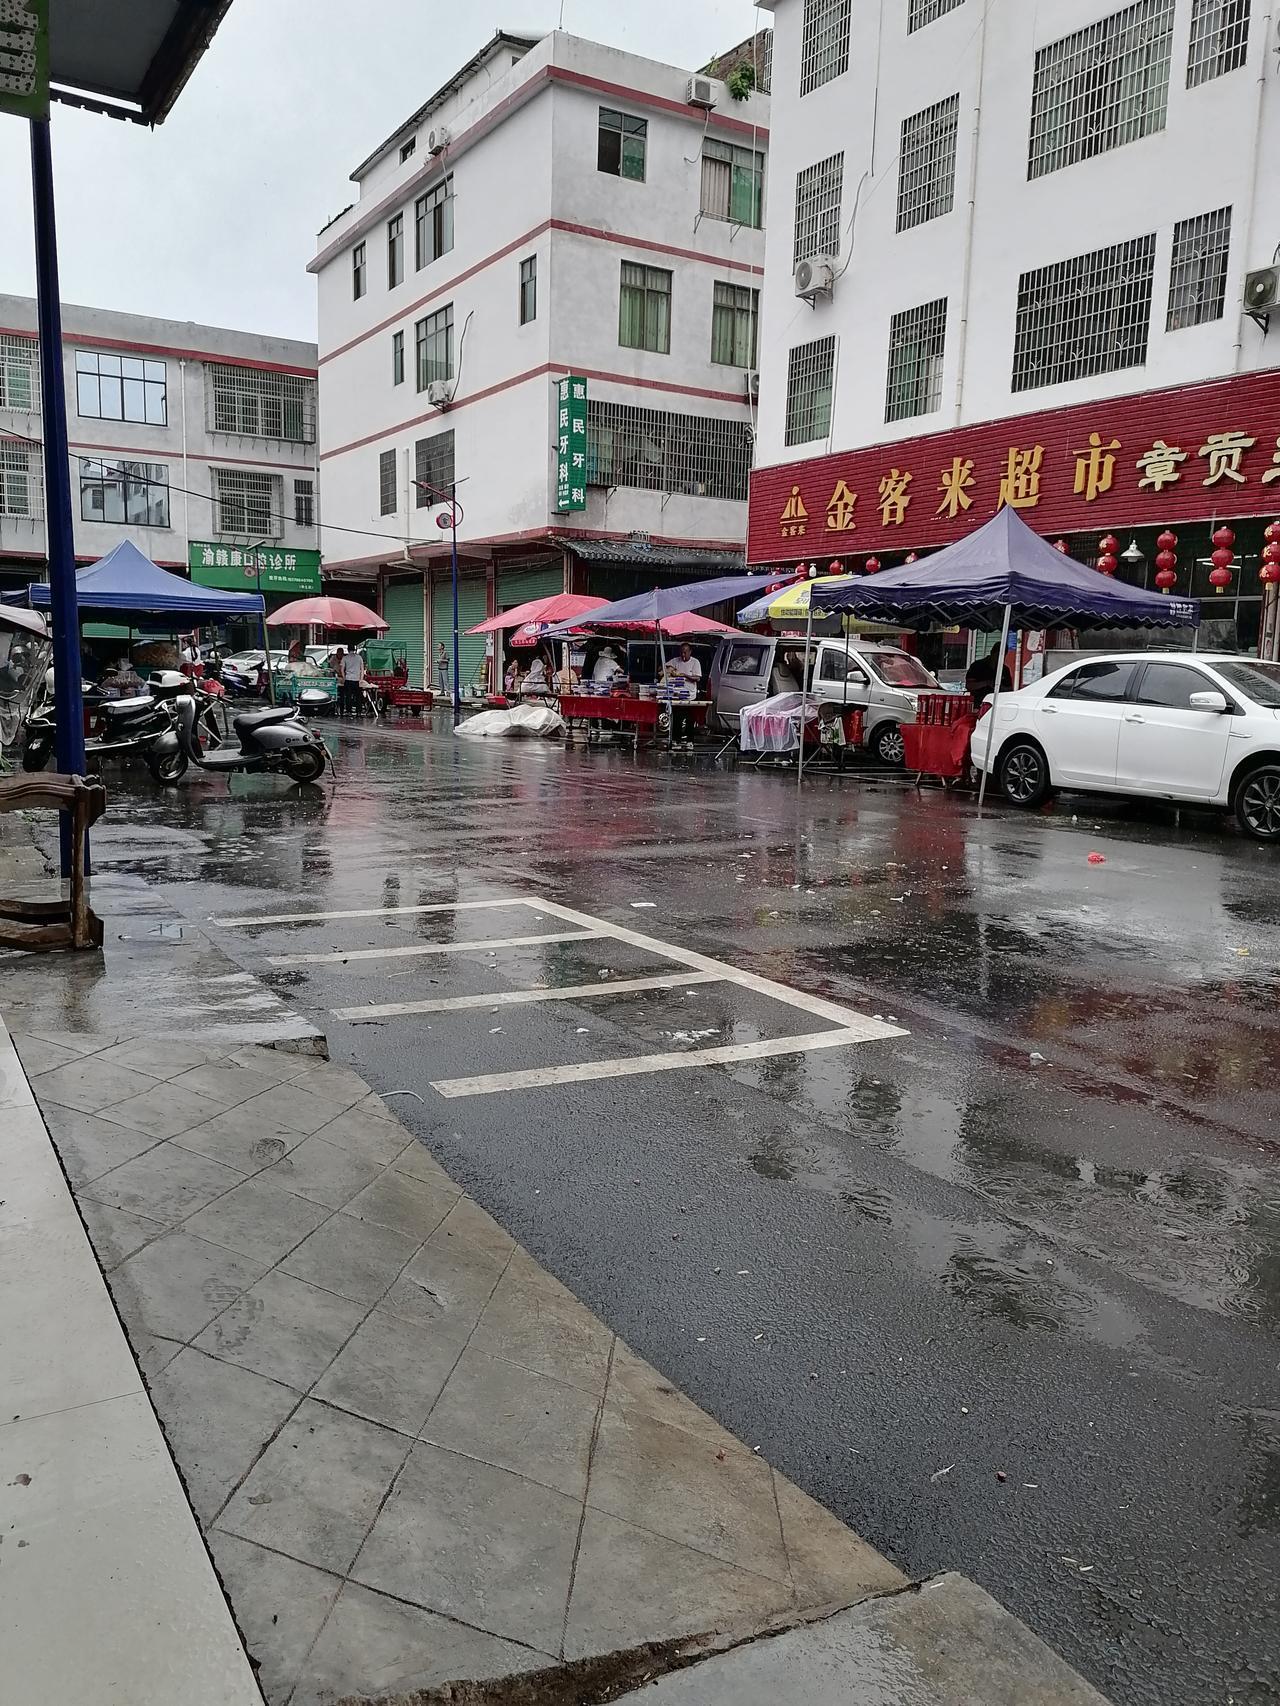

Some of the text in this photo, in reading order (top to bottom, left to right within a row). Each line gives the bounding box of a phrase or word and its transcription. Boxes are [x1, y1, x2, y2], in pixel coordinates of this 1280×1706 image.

[559, 380, 569, 483] 惠民牙科
[572, 383, 585, 503] 惠民牙科
[825, 431, 1122, 531] 金客来超市
